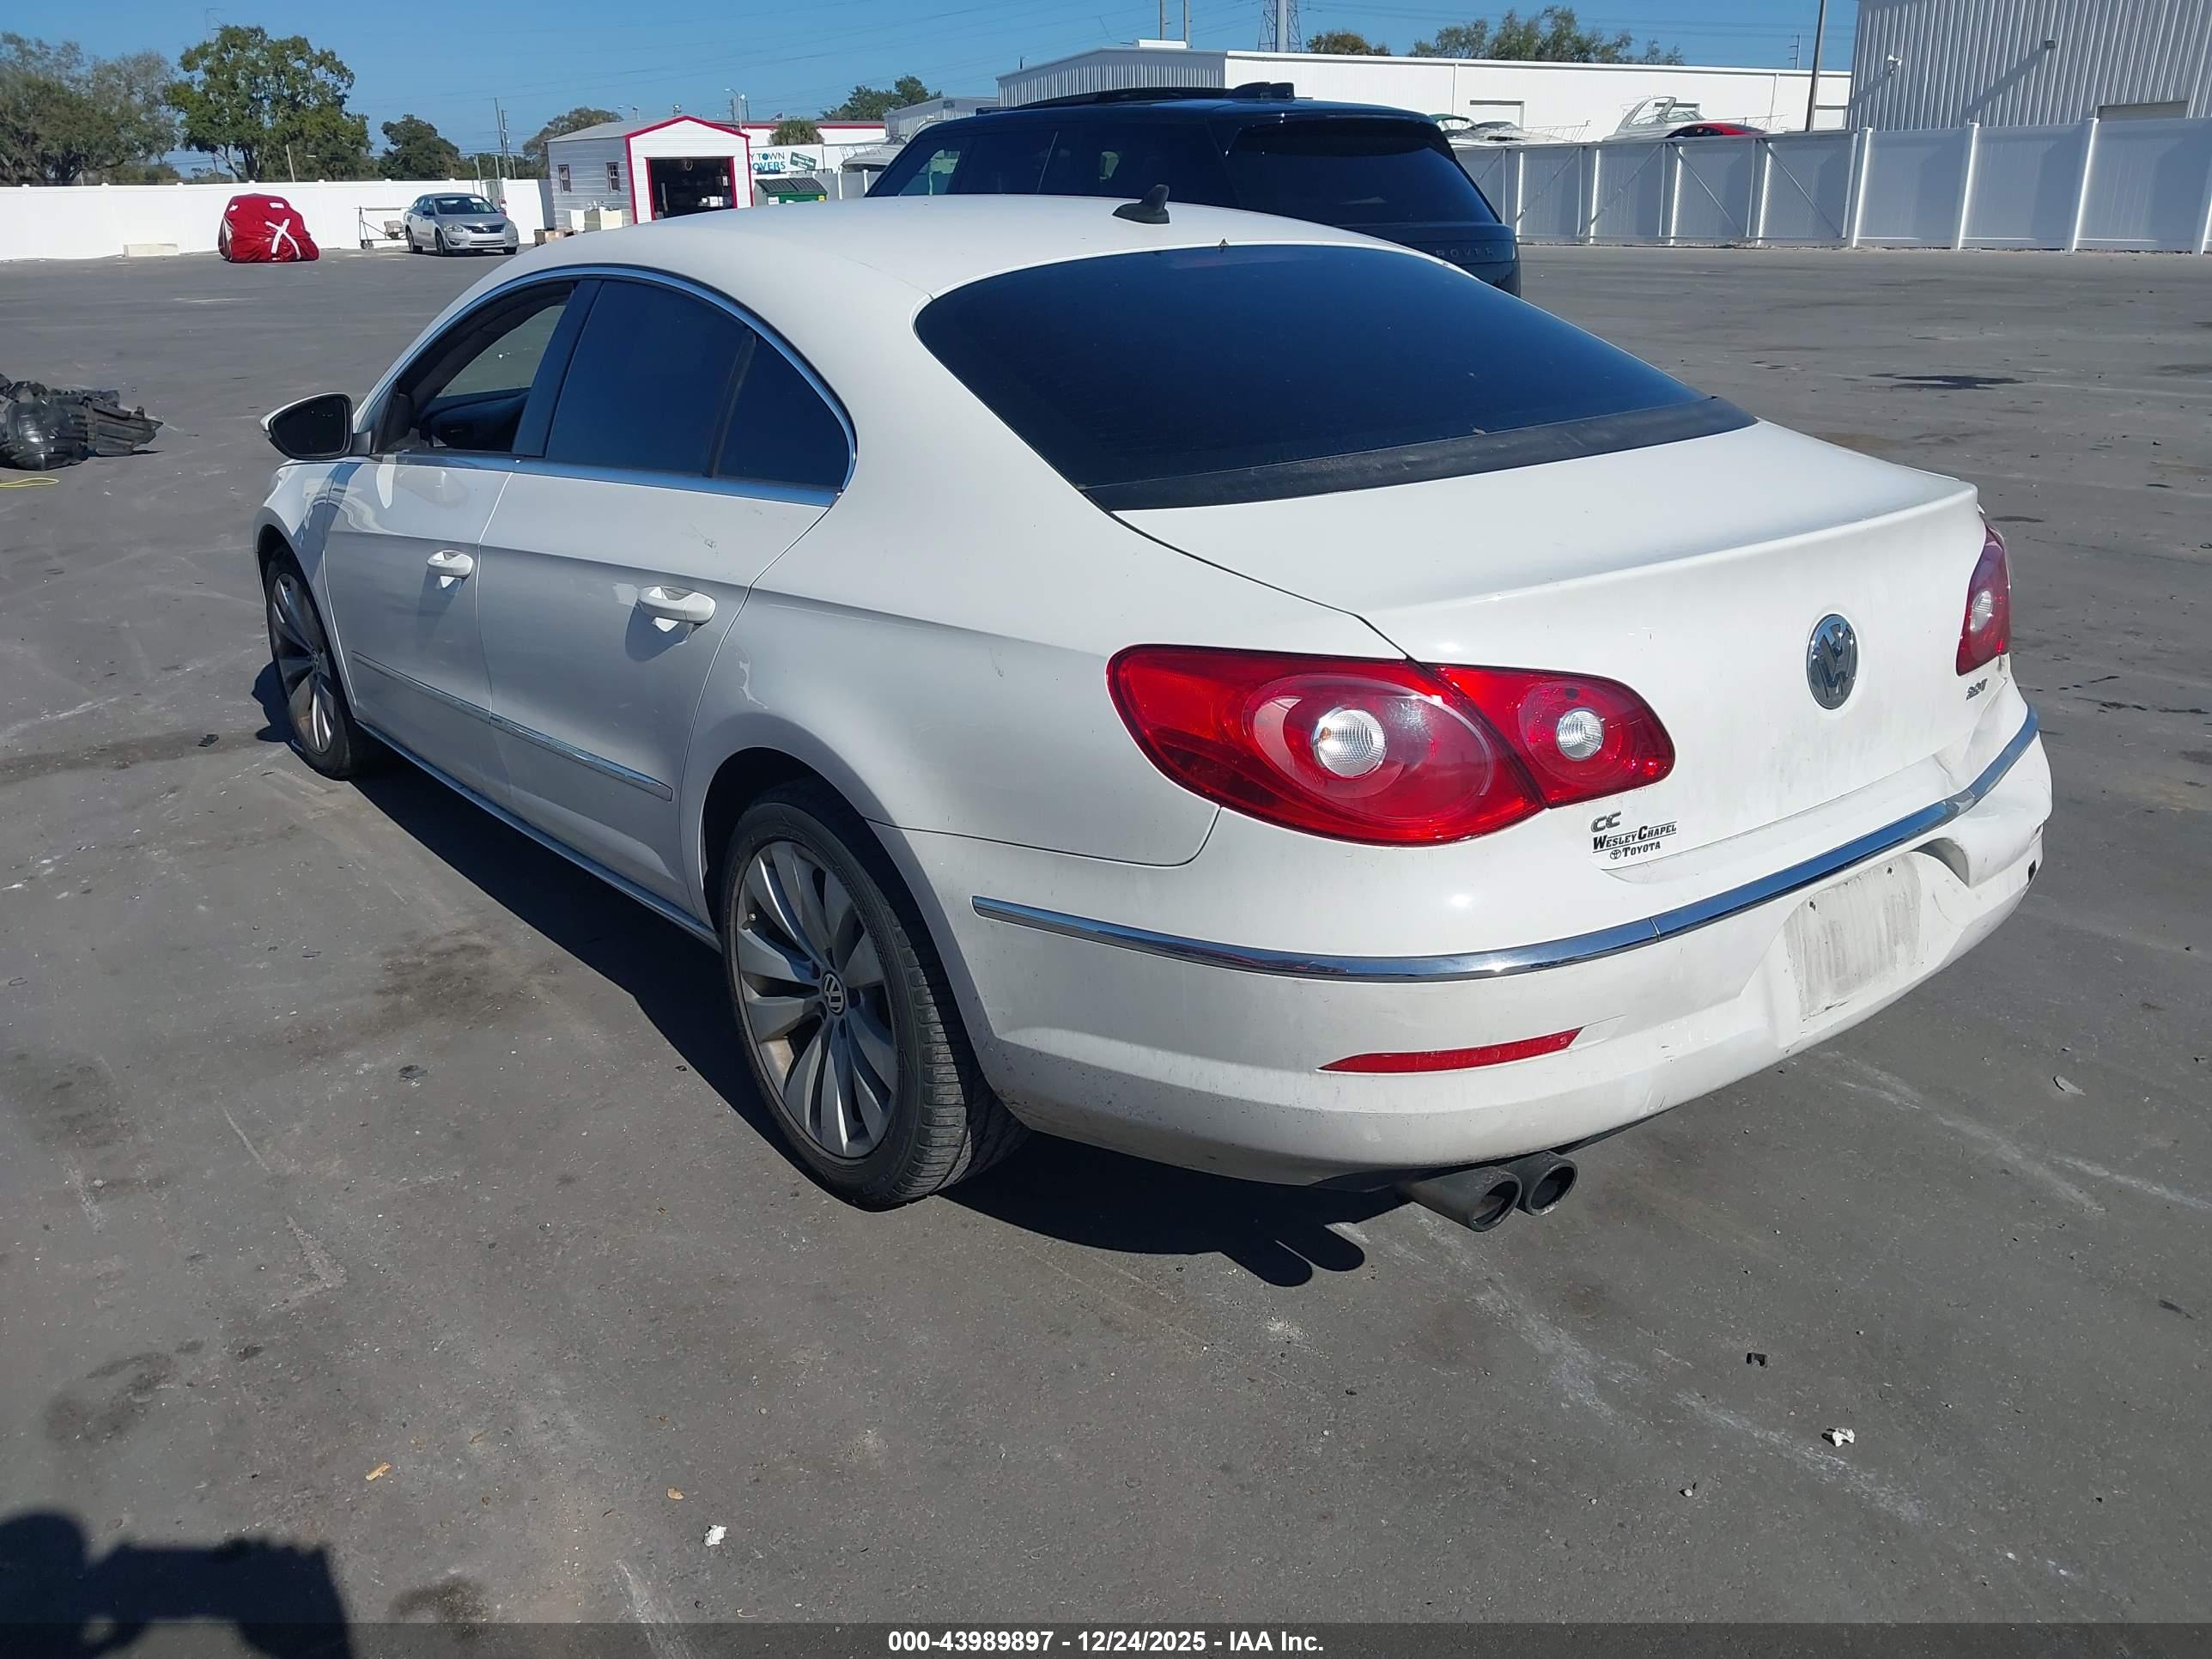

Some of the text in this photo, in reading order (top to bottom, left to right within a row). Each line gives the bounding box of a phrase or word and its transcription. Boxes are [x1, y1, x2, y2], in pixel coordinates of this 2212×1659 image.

[756, 152, 785, 161] TOWN
[750, 161, 787, 172] OVERS
[1590, 810, 1621, 832] CC
[1622, 841, 1661, 857] TOYOTA
